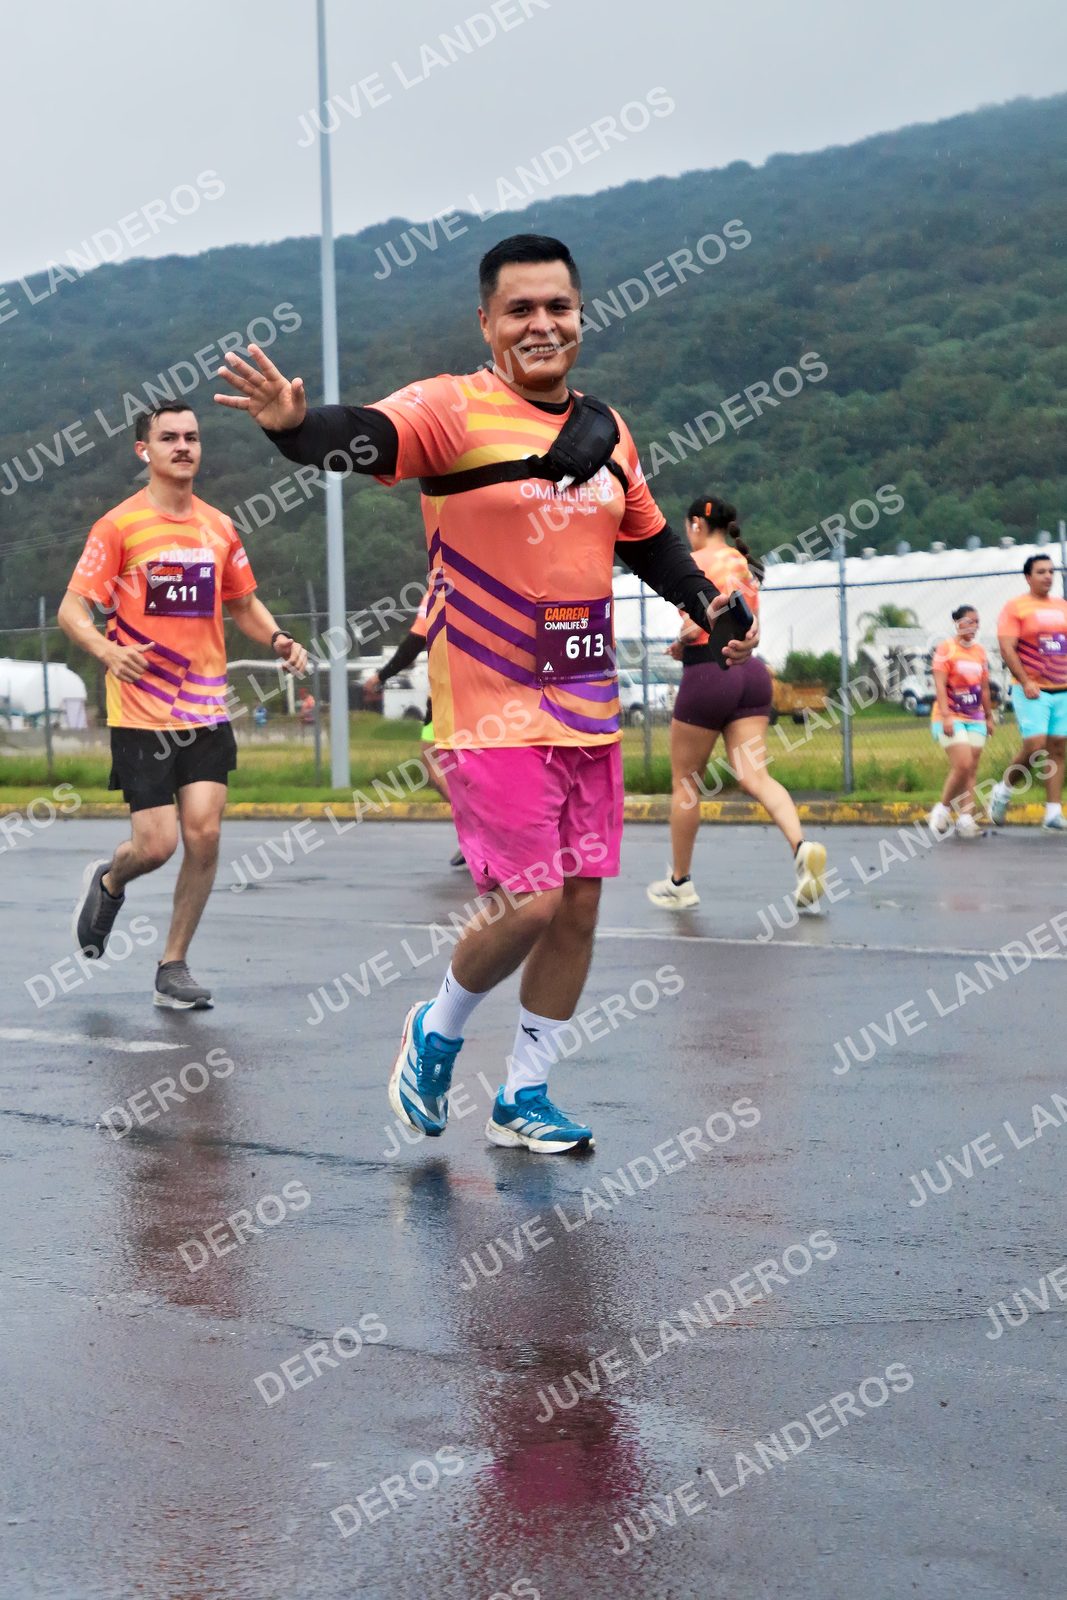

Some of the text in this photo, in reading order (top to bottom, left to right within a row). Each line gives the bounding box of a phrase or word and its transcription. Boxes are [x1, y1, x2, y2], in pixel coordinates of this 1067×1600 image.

[166, 585, 198, 602] 411
[544, 606, 590, 621] CARRERA
[544, 620, 581, 630] OMNILIFE
[565, 633, 604, 659] 613
